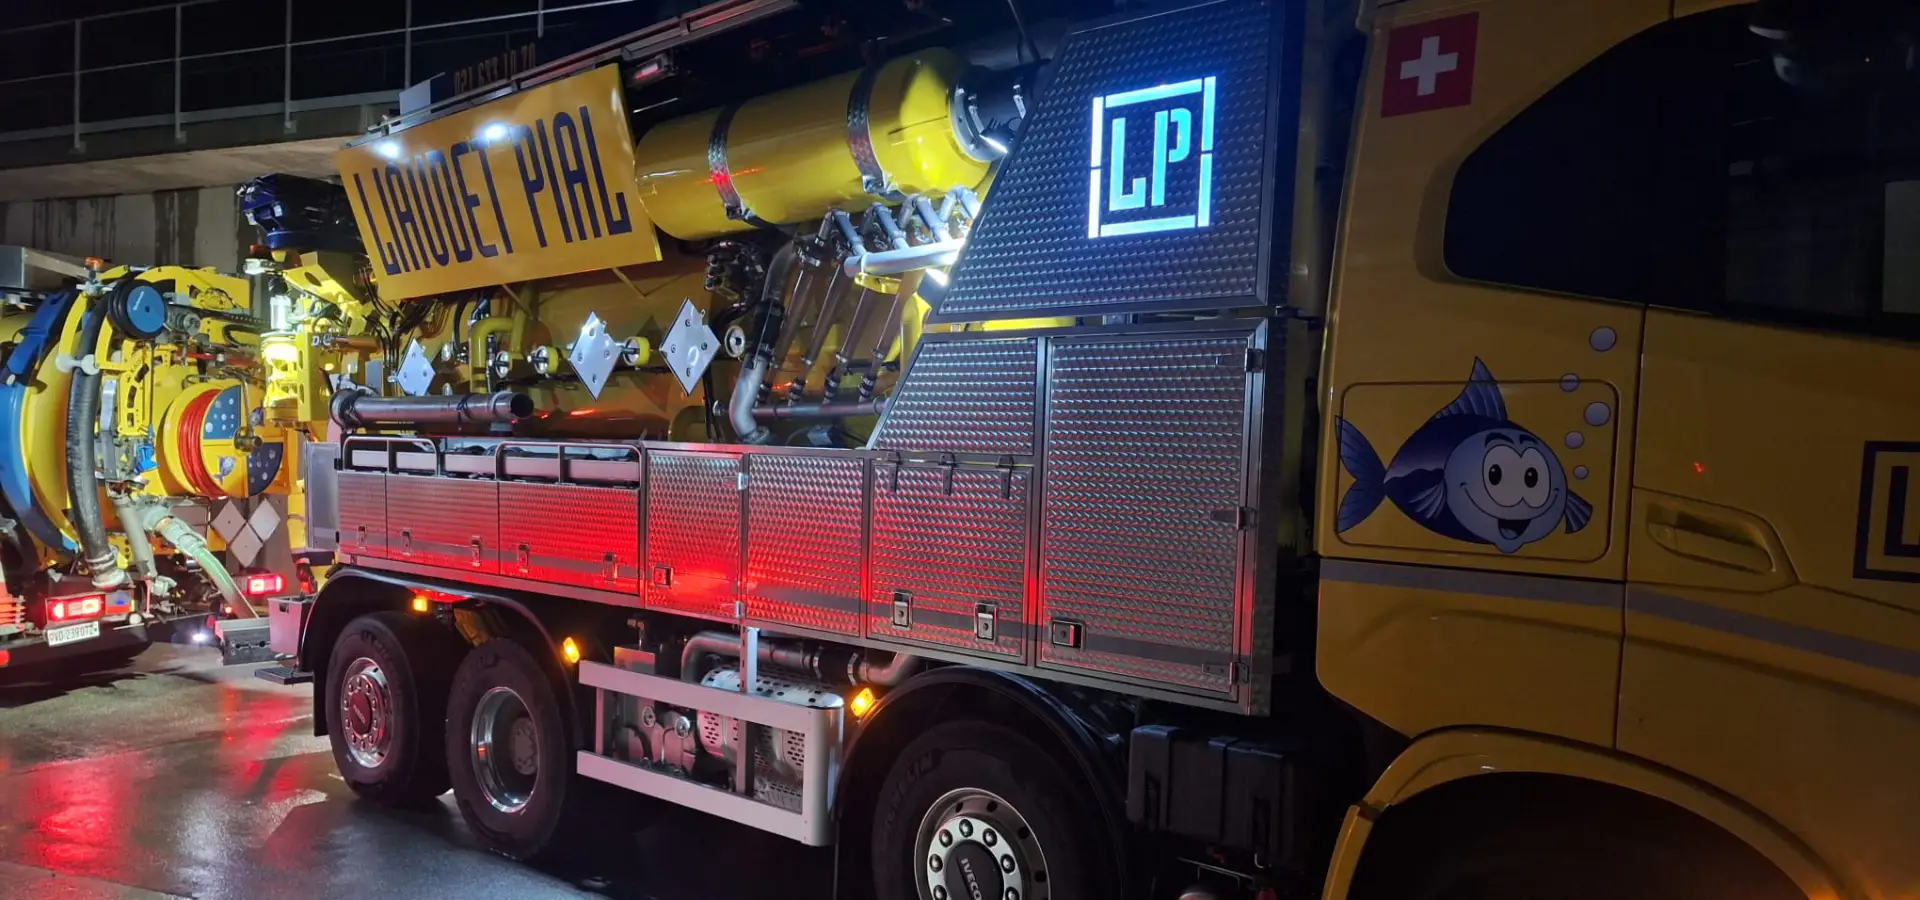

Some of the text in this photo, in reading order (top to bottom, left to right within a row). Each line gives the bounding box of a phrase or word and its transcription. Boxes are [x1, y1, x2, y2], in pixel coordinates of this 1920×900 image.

[353, 105, 633, 276] LIAUDET PIAL
[1109, 107, 1192, 211] LP
[961, 857, 983, 900] IVECO
